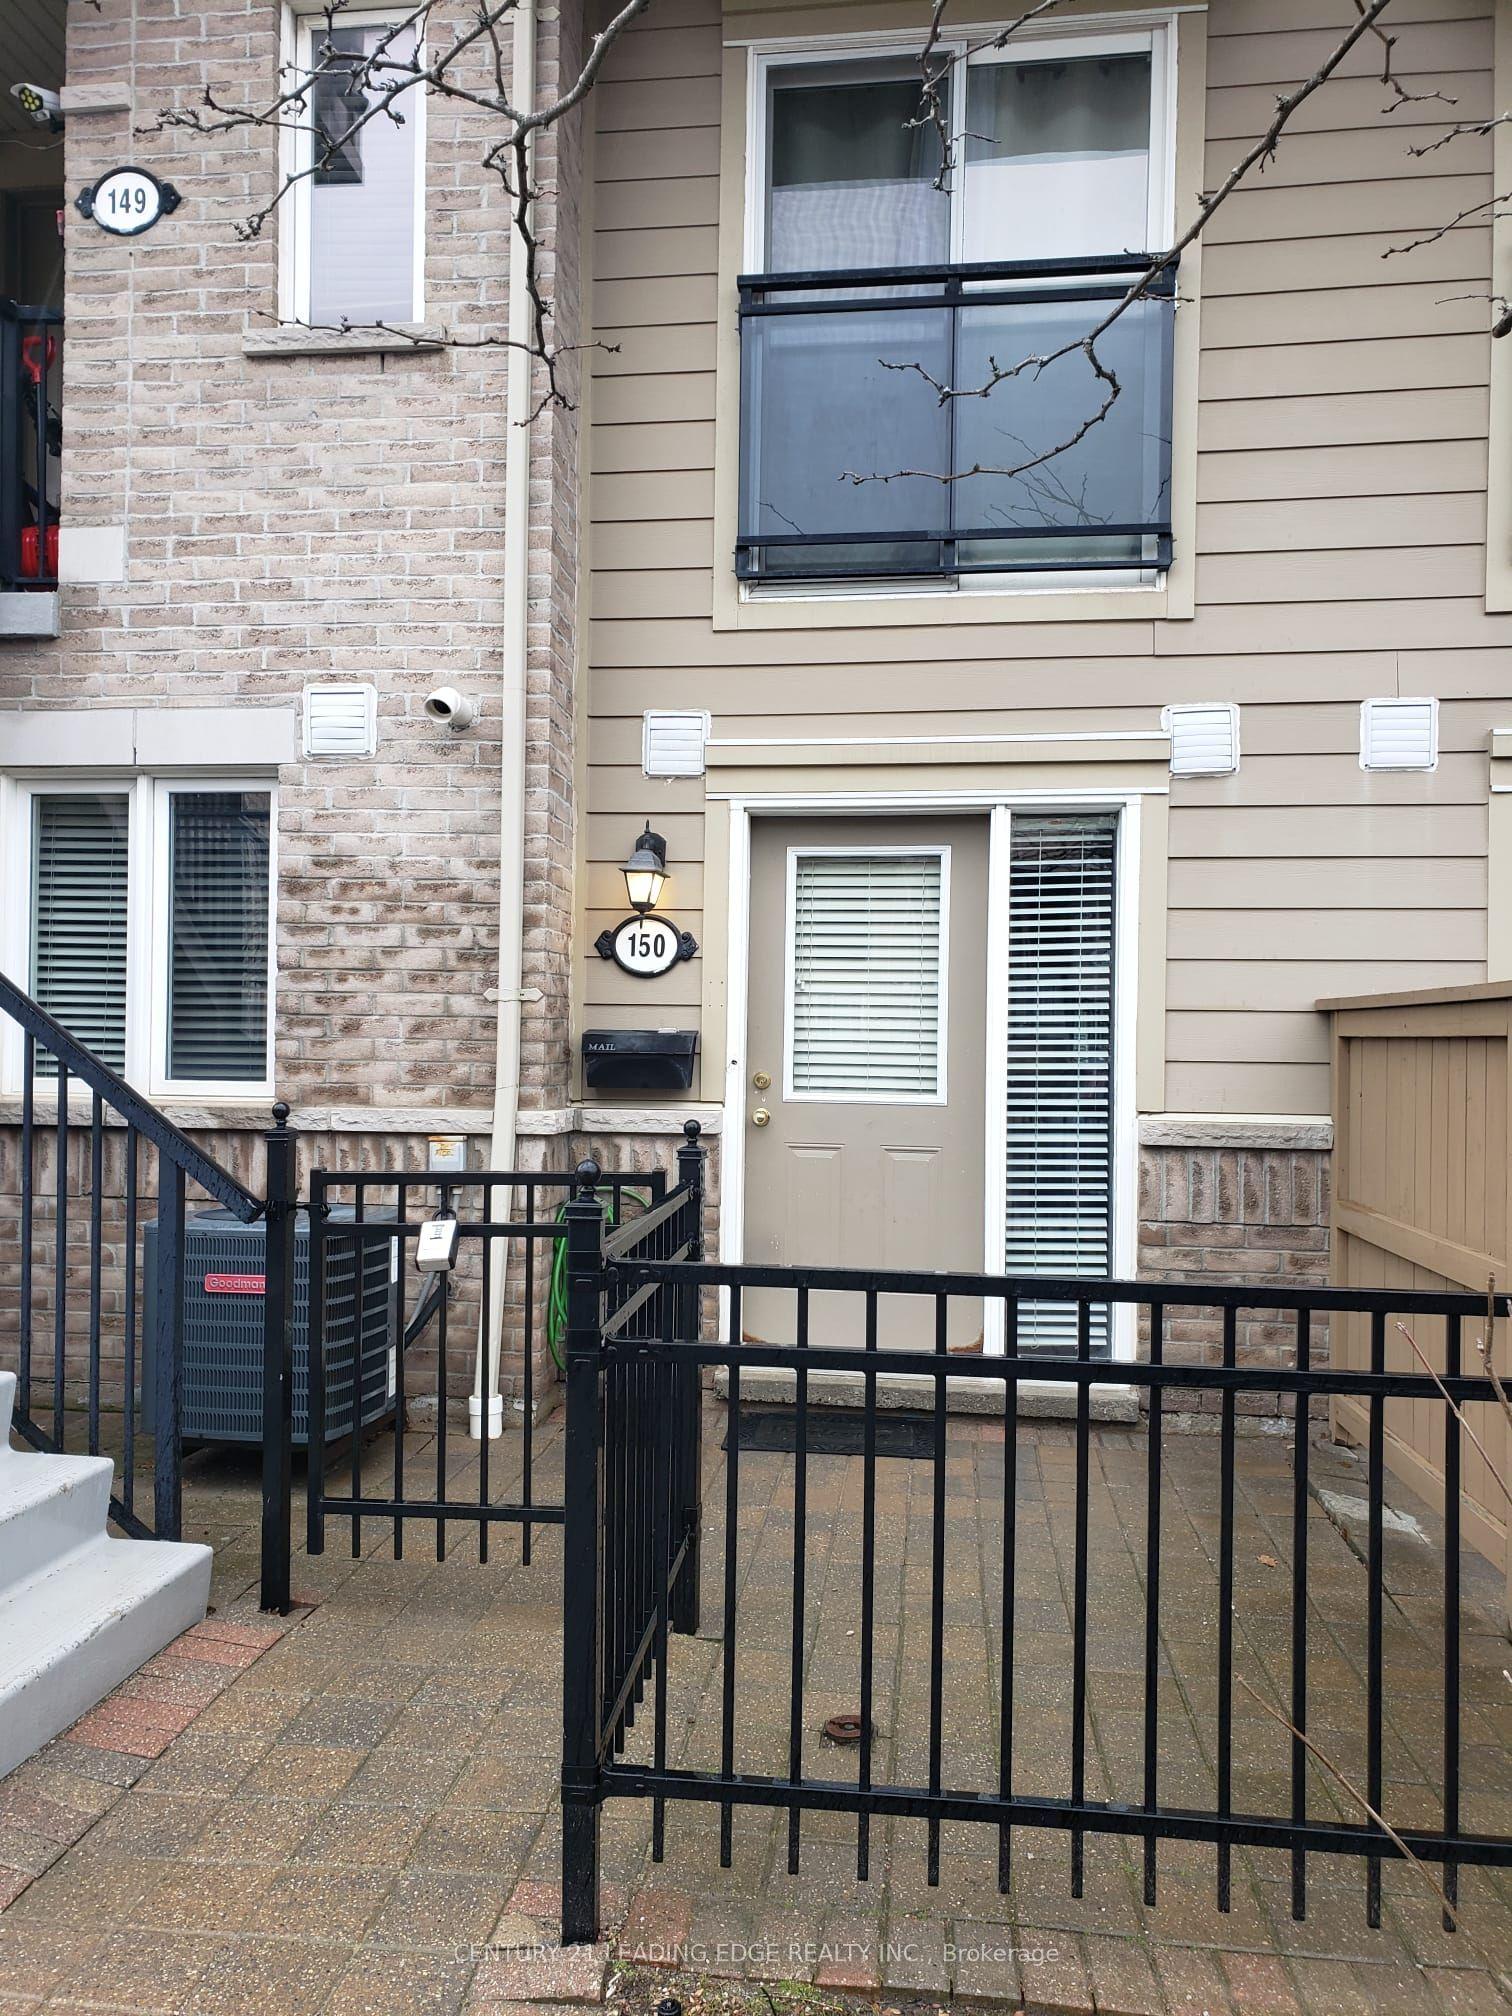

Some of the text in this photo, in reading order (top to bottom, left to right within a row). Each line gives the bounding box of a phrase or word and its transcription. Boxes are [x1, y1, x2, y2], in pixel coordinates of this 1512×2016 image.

[108, 187, 146, 214] 149
[628, 933, 665, 957] 150
[588, 1043, 616, 1051] MAIL
